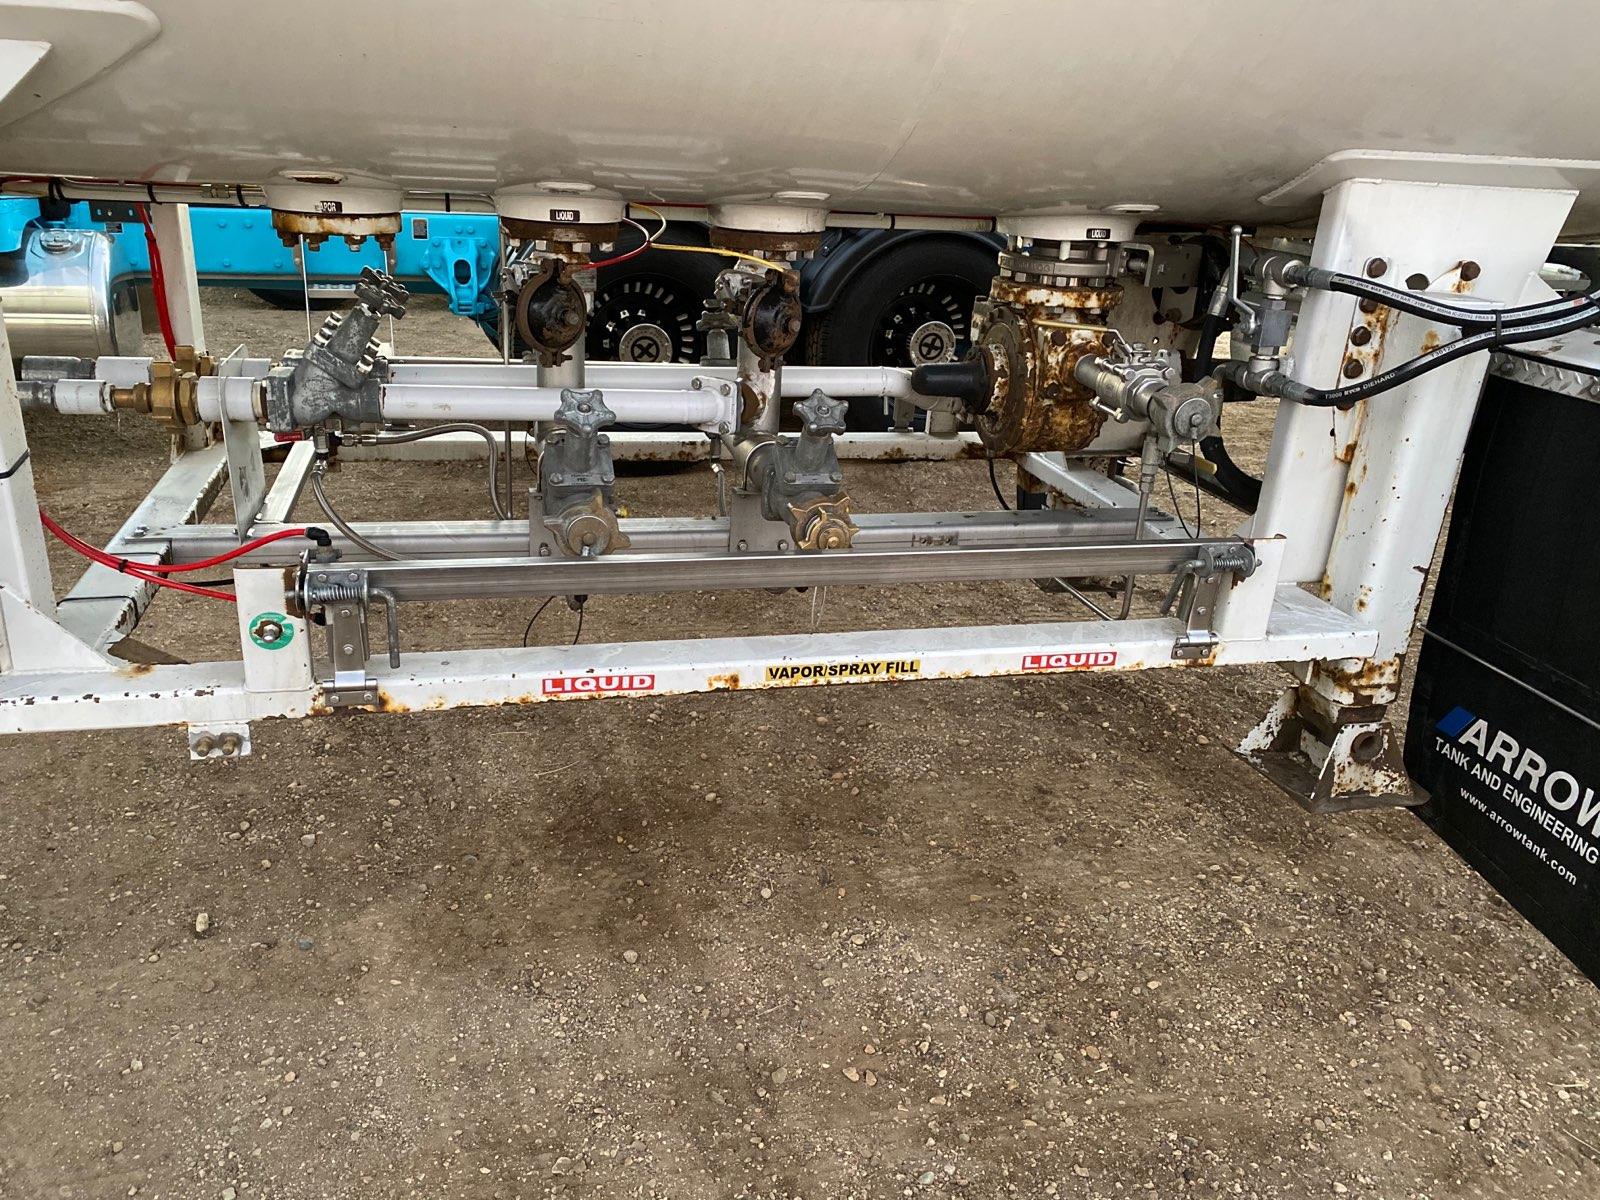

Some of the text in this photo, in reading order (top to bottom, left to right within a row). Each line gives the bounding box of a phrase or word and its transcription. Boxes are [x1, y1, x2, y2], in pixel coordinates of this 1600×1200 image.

[1362, 373, 1396, 390] DIEHARD
[1024, 652, 1114, 668] LIQUID
[768, 661, 918, 680] VAPOR/SPRAY FILL
[544, 675, 652, 692] LIQUID
[1435, 736, 1599, 864] TANK AND ENGINEERING
[1460, 787, 1577, 886] www.arrowtank.com
